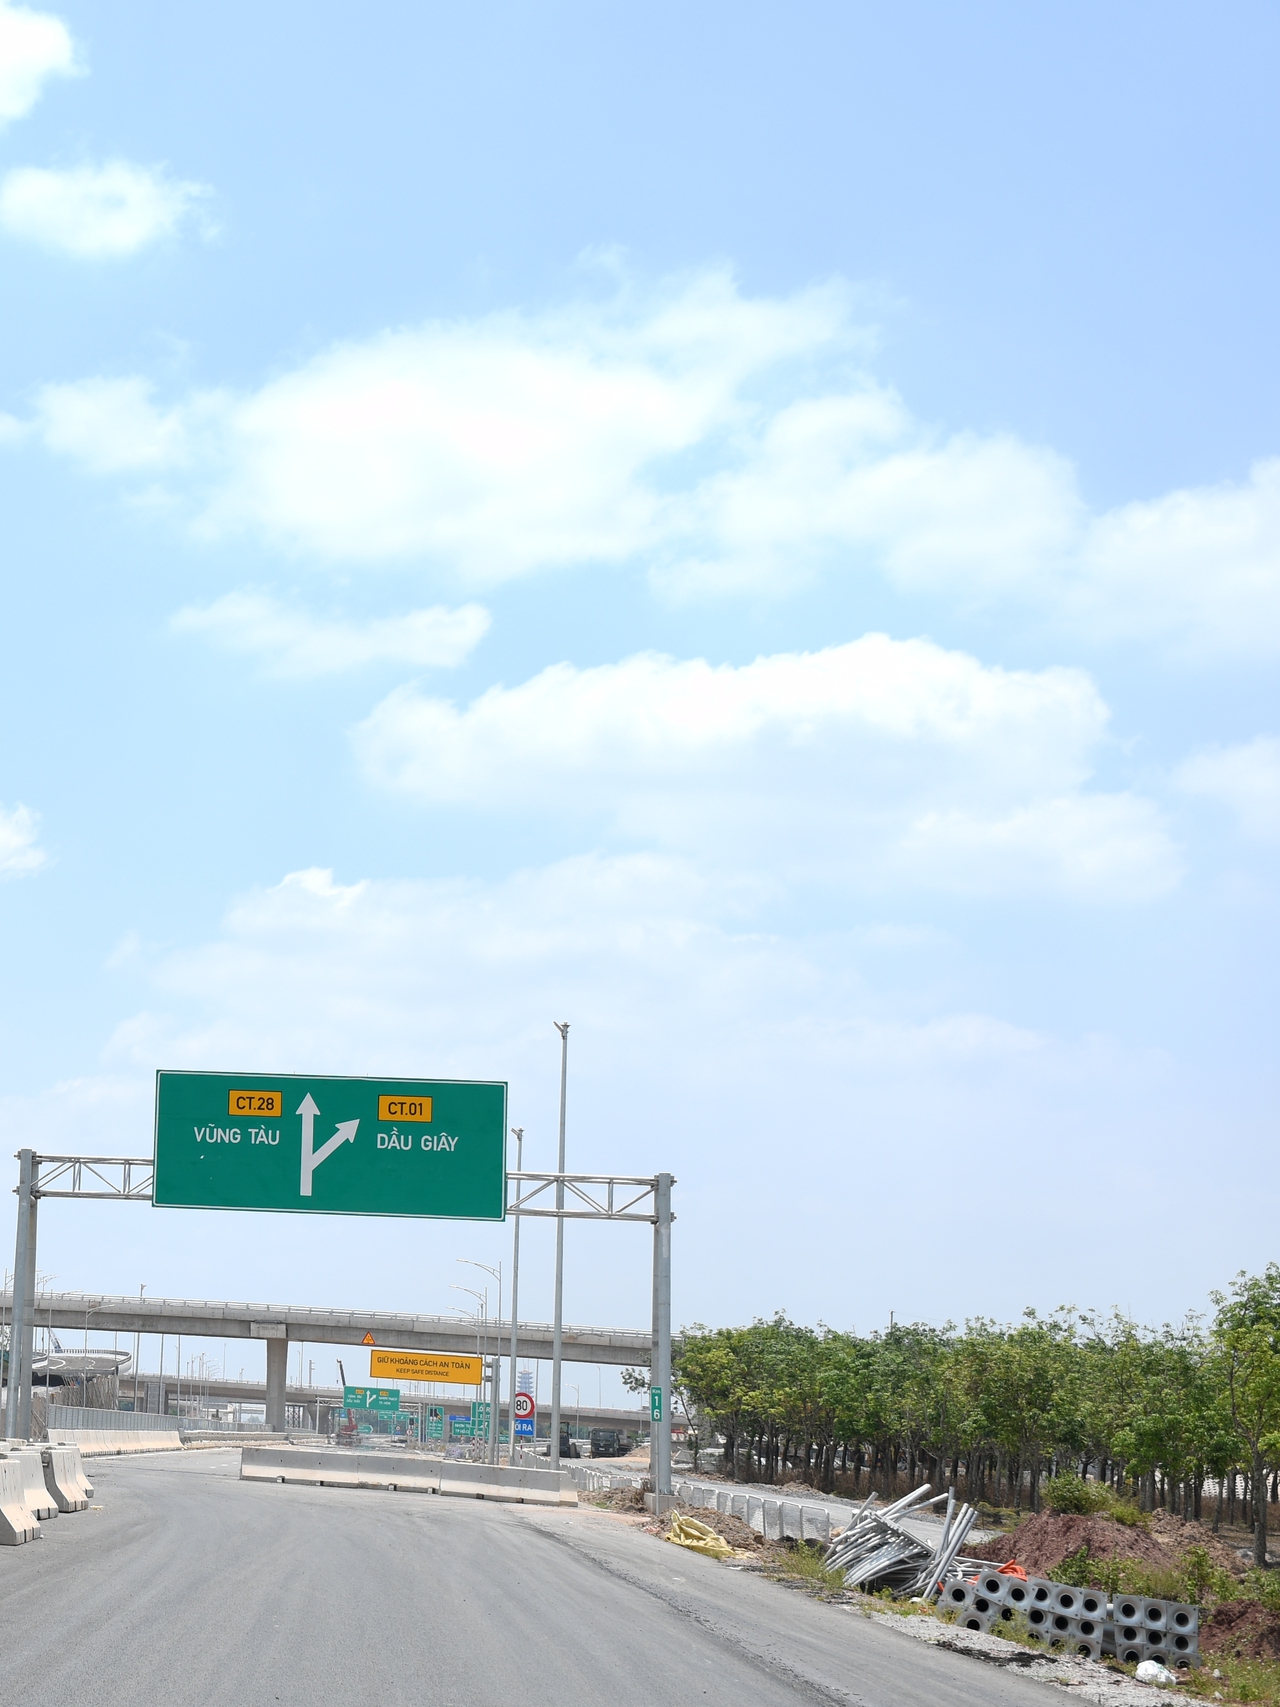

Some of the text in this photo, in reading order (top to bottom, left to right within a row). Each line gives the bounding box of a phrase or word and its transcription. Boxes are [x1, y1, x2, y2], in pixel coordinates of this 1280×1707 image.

[236, 1096, 275, 1111] CT.28
[388, 1101, 423, 1116] CT.01
[193, 1123, 280, 1145] VŨNG TÀU
[377, 1126, 459, 1152] DẦU GIÂY
[377, 1356, 471, 1369] GIỮ KHOẢNG CÁCH AN TOÀN
[516, 1400, 528, 1411] 80
[522, 1424, 532, 1432] RA
